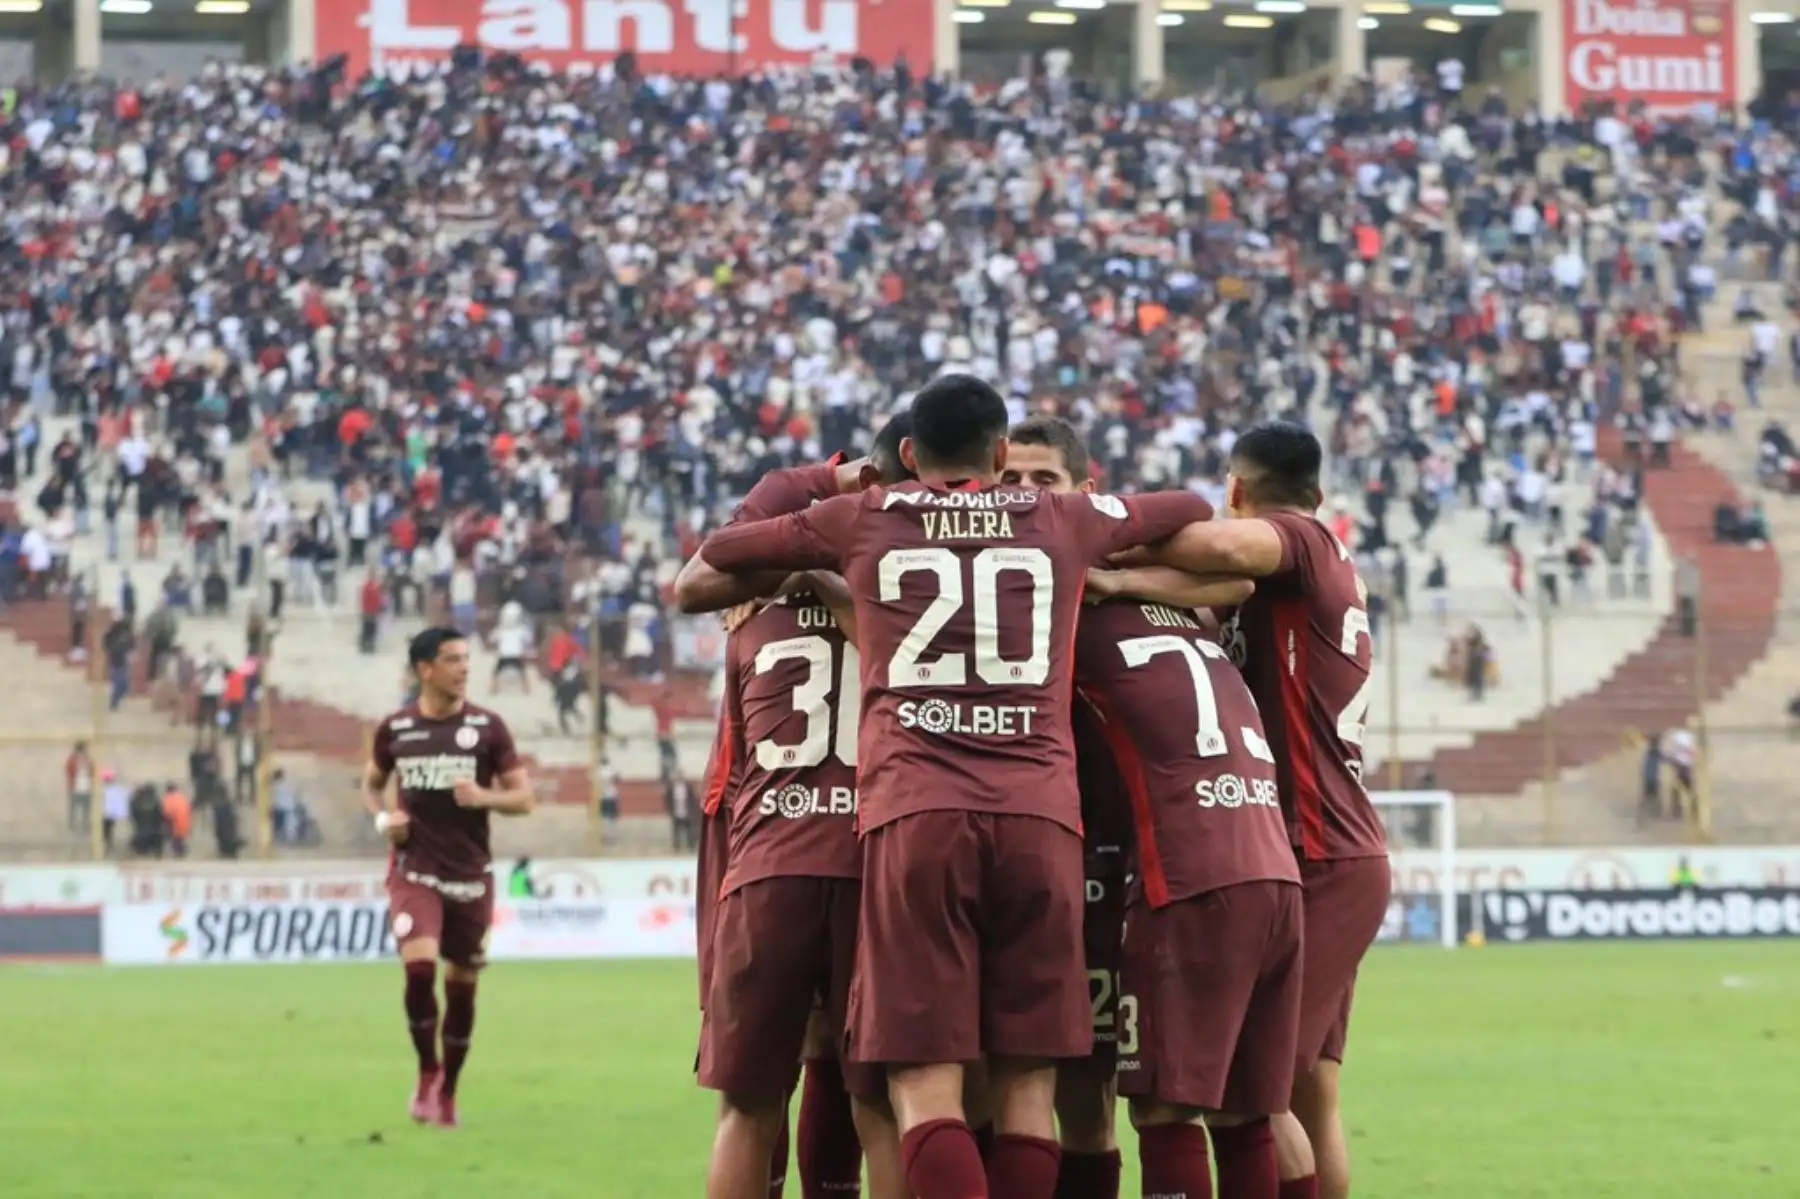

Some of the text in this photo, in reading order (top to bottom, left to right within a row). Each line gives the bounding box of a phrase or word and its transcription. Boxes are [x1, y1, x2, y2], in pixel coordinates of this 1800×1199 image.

[1569, 41, 1724, 92] Gumi
[921, 510, 1014, 540] VALERA
[878, 547, 1053, 688] 20
[897, 698, 1037, 734] SOLBET
[1546, 891, 1800, 936] DoradoBet
